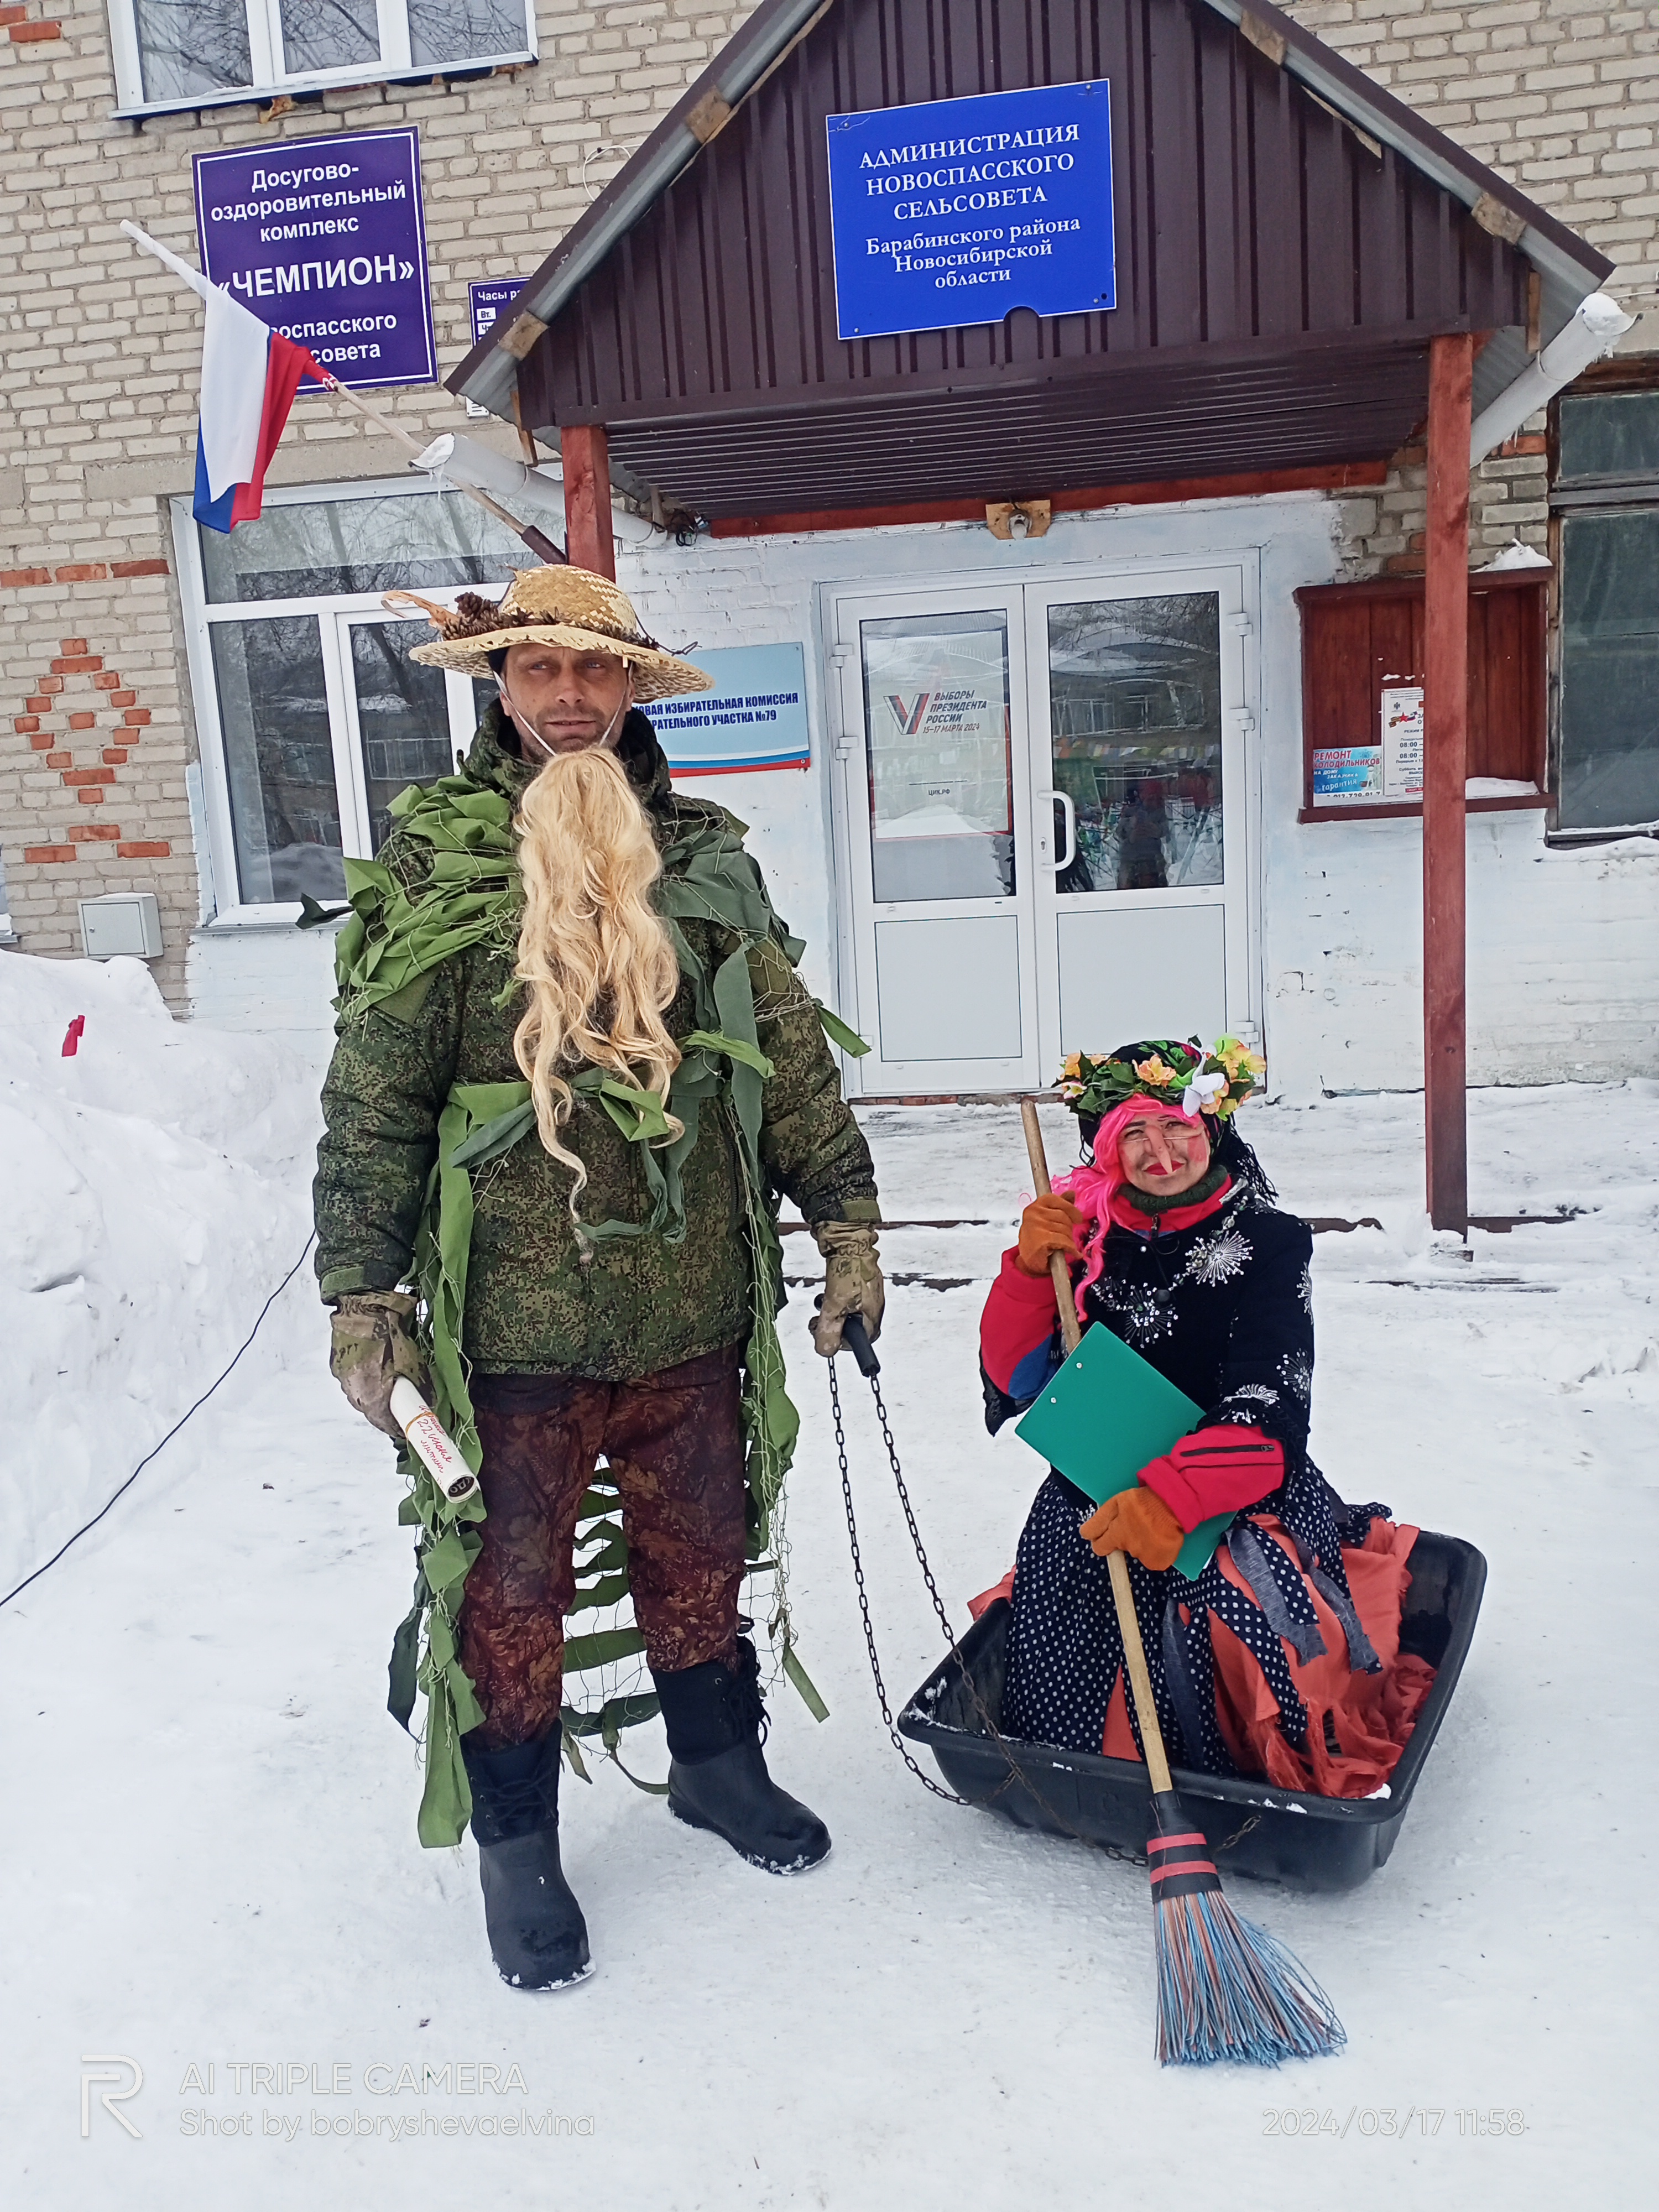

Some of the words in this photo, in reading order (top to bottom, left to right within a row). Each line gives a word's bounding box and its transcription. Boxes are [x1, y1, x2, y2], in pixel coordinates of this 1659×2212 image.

[859, 124, 1080, 169] АДМИНИСТРАЦИЯ
[251, 163, 359, 192] Досугово-
[866, 153, 1074, 196] НОВОСПАССКОГО
[210, 180, 406, 221] оздоровительный
[894, 185, 1047, 220] СЕЛЬСОВЕТА
[260, 215, 359, 242] комплекс
[865, 228, 1004, 258] Барабинского
[1009, 217, 1081, 243] района
[894, 239, 1053, 273] Новосибирской
[935, 268, 1011, 289] области
[478, 290, 507, 301] Часы
[270, 311, 397, 339] оспасского
[310, 341, 381, 363] совета
[635, 704, 664, 716] ОВАЯ
[665, 697, 744, 714] ИЗБИРАТЕЛЬНАЯ
[745, 692, 799, 707] КОМИССИЯ
[930, 701, 987, 712] ПРЕЗИДЕНТА
[933, 690, 975, 701] ВЫБОРЫ
[651, 716, 710, 730] РАТЕЛЬНОГО
[712, 711, 754, 726] УЧАСТКА
[755, 709, 776, 722] №79
[926, 713, 963, 724] РОССИИ
[941, 724, 963, 732] МАРТА
[964, 723, 980, 731] 2024
[1314, 750, 1352, 760] РЕМОНТ
[1314, 758, 1380, 768] ХОЛОДИЛЬНИКОВ
[1322, 779, 1358, 791] гарантия
